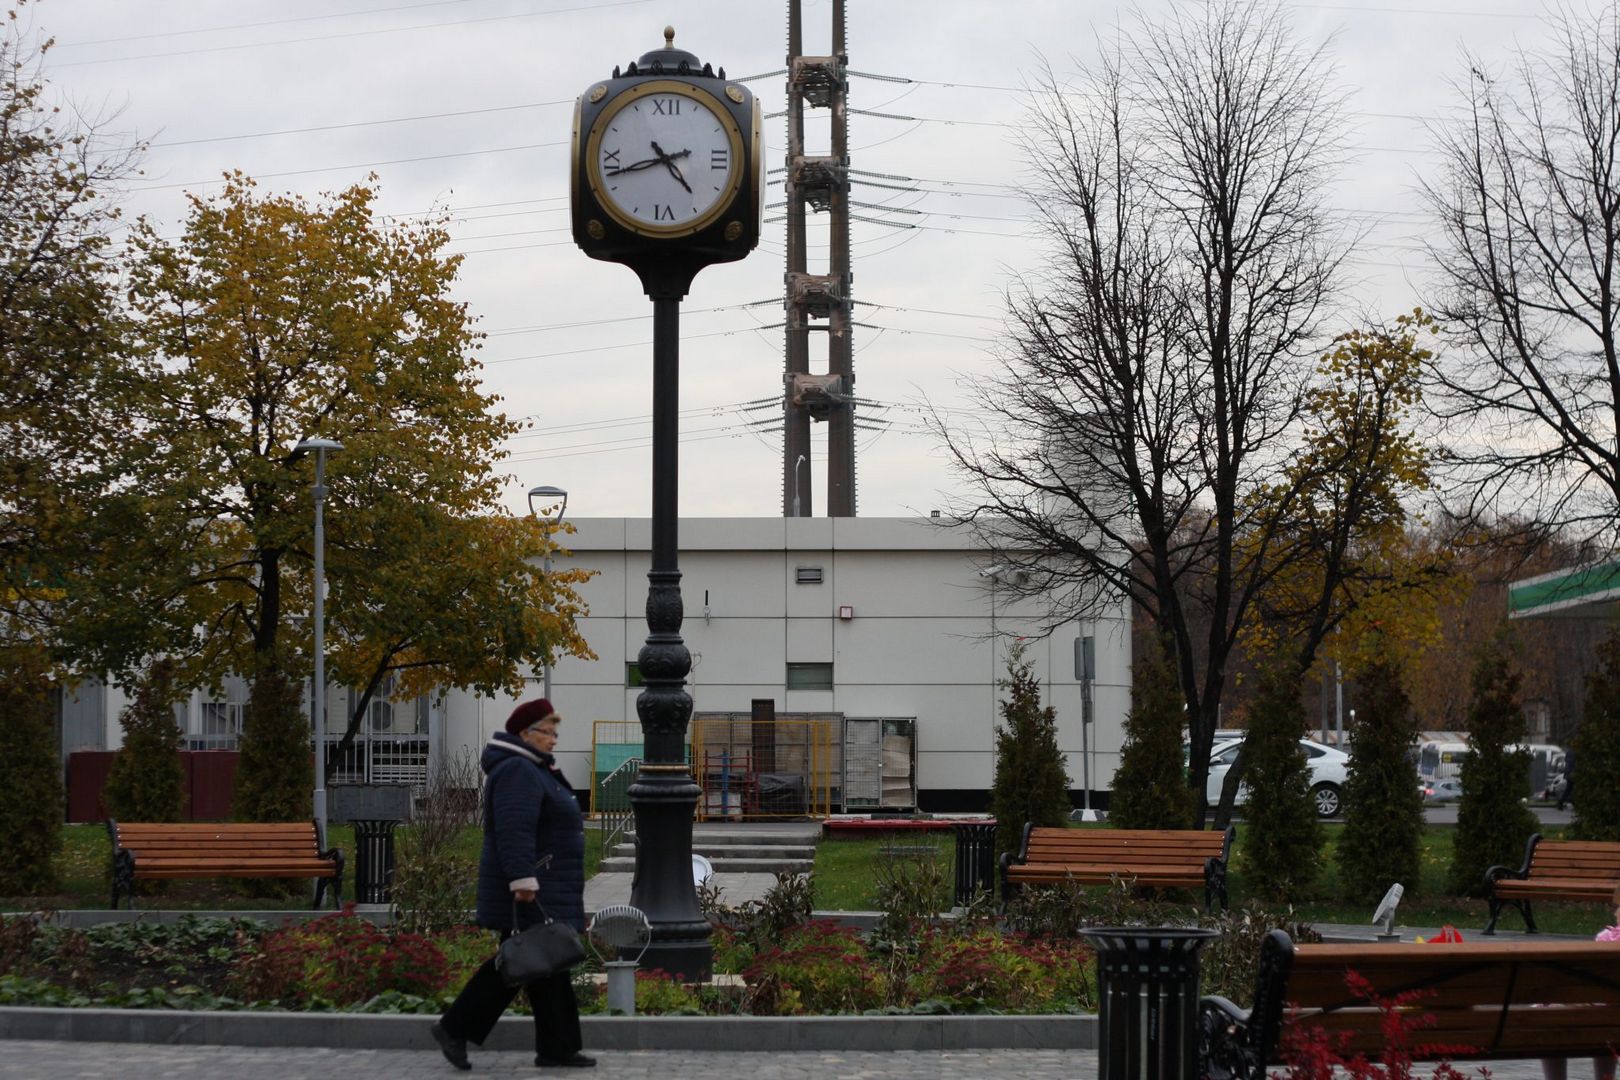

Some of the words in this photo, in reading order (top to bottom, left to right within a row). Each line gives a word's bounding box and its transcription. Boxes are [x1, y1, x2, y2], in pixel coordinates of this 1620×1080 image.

[652, 99, 680, 115] XII
[604, 149, 620, 171] IX
[711, 149, 727, 170] III
[654, 205, 676, 220] VI
